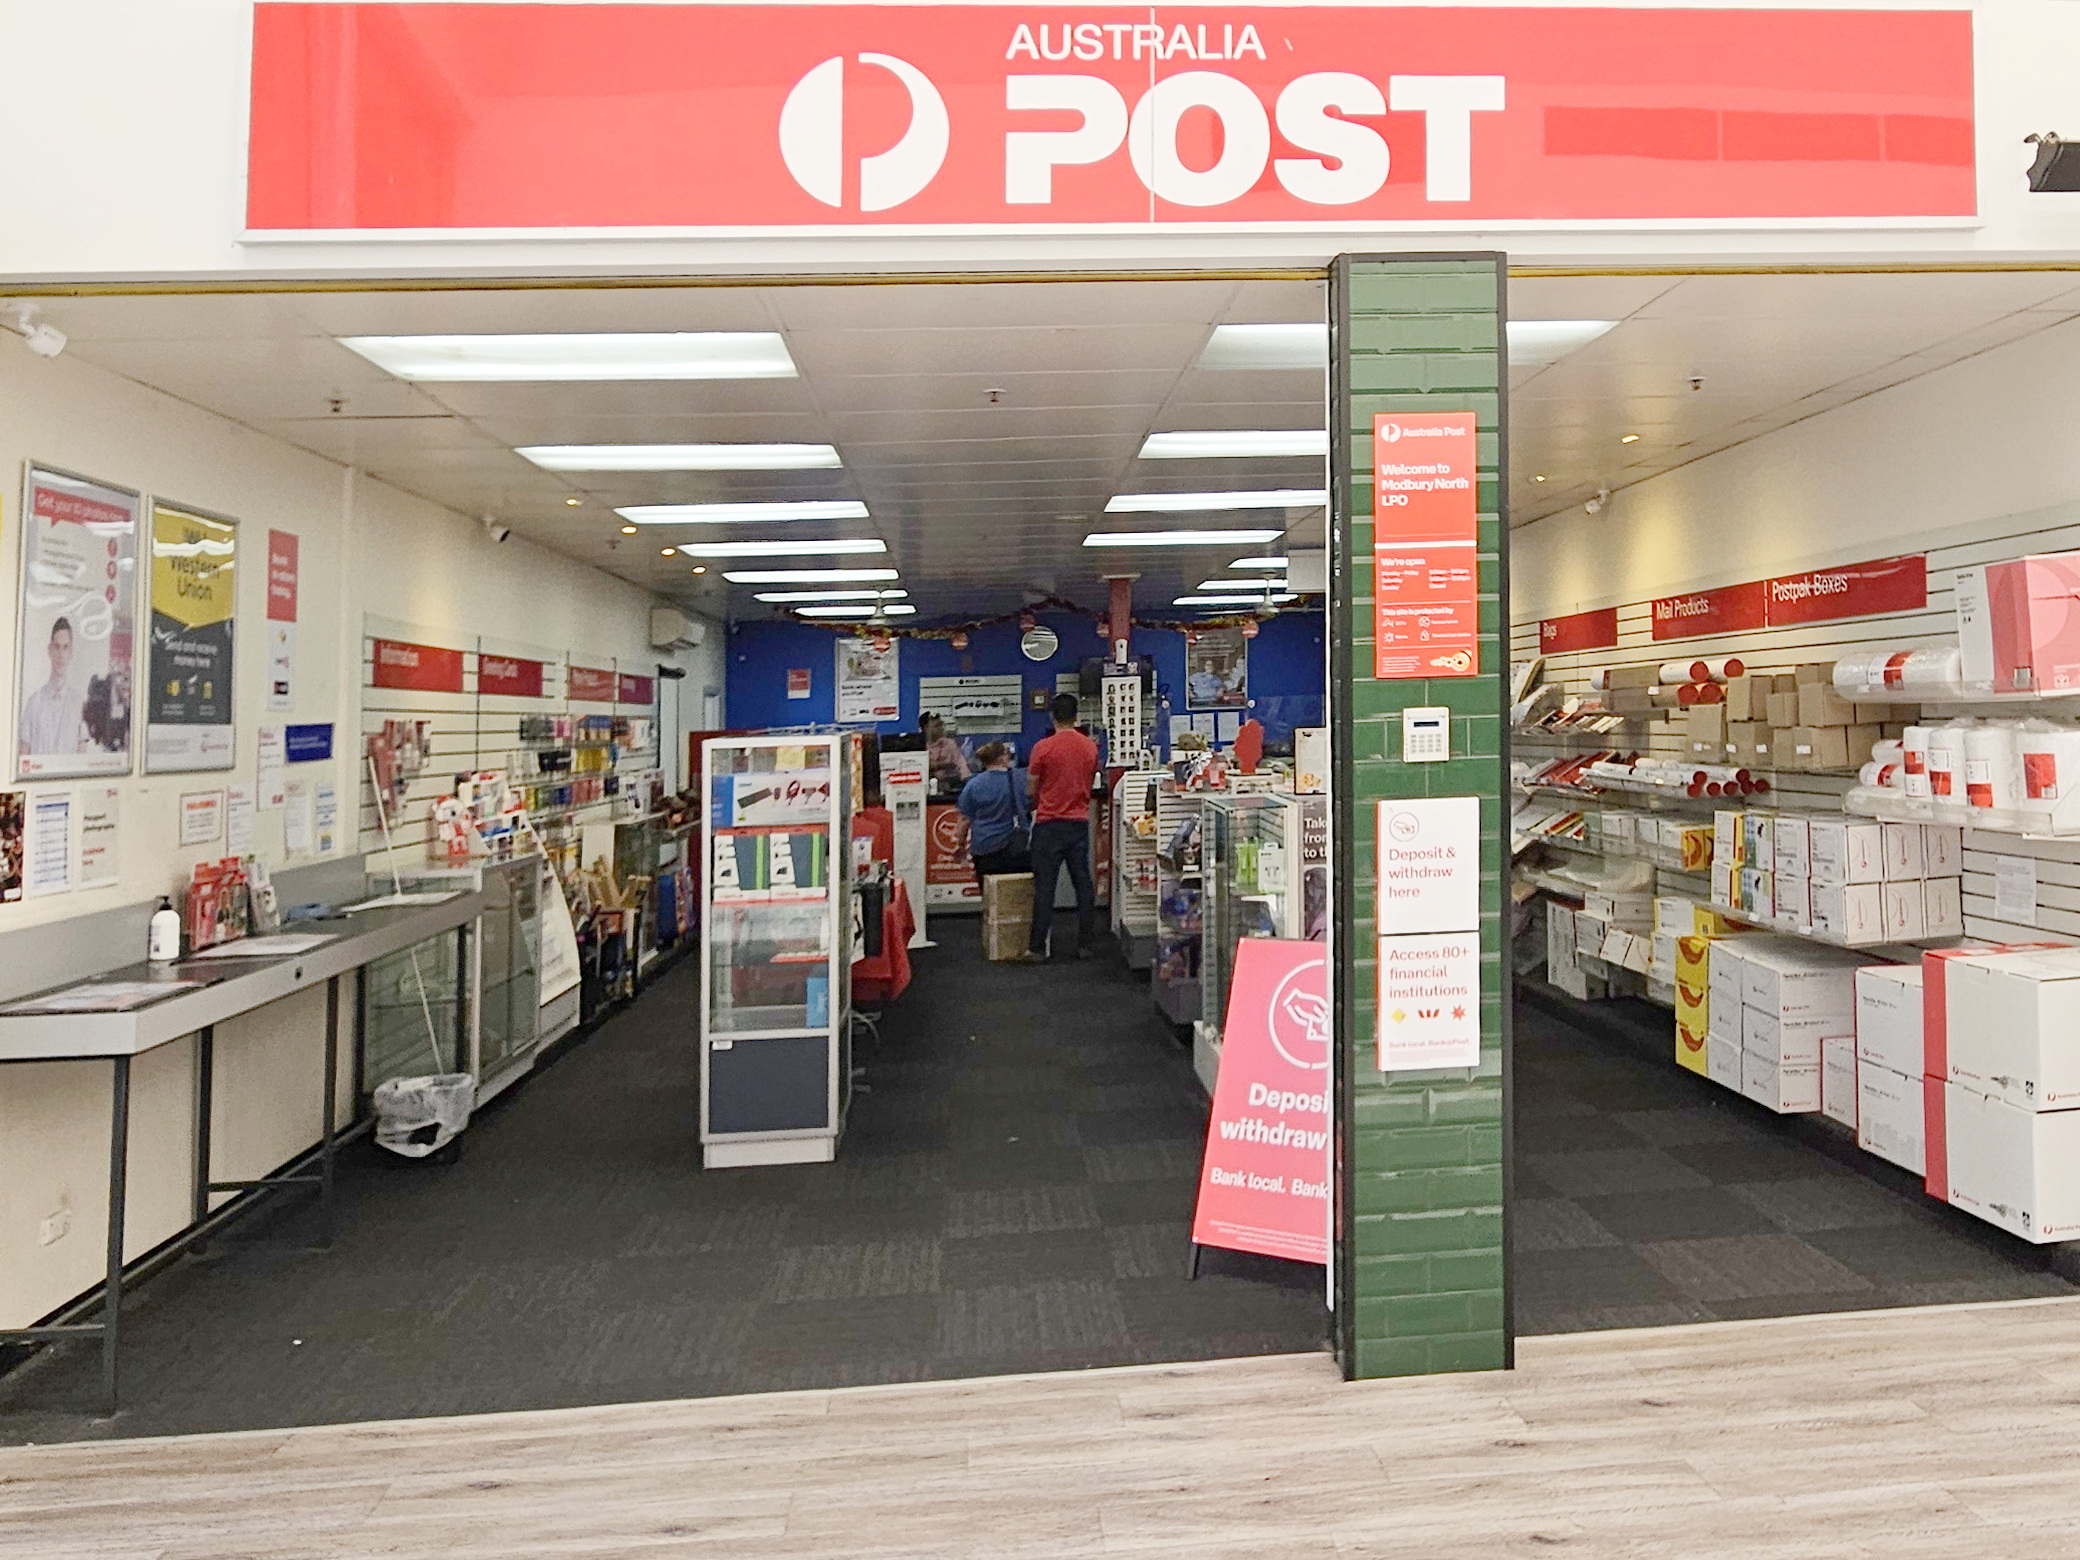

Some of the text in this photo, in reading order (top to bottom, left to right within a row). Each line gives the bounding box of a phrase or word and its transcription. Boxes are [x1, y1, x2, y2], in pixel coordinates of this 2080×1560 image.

[1006, 23, 1267, 61] AUSTRALIA
[1006, 71, 1506, 207] POST
[1402, 426, 1466, 437] Australia Post
[1381, 463, 1451, 475] Welcome to
[1381, 477, 1469, 492] Modbury North
[1381, 494, 1409, 506] LPO
[1381, 557, 1426, 567] We're open
[177, 576, 213, 600] Union
[1772, 573, 1848, 604] Postpak Boxes
[1656, 597, 1709, 620] Mail Products
[1303, 816, 1327, 829] Tak
[1304, 847, 1318, 858] to
[1389, 846, 1456, 862] Deposit &
[1388, 866, 1453, 879] withdraw
[1389, 886, 1420, 898] here
[1389, 946, 1469, 961] Access 80+
[1389, 965, 1448, 980] financial
[1389, 984, 1468, 998] institutions
[1248, 1082, 1328, 1114] Deposi
[1220, 1116, 1328, 1151] withdraw
[1210, 1166, 1247, 1188] Bank
[1247, 1171, 1287, 1194] local.
